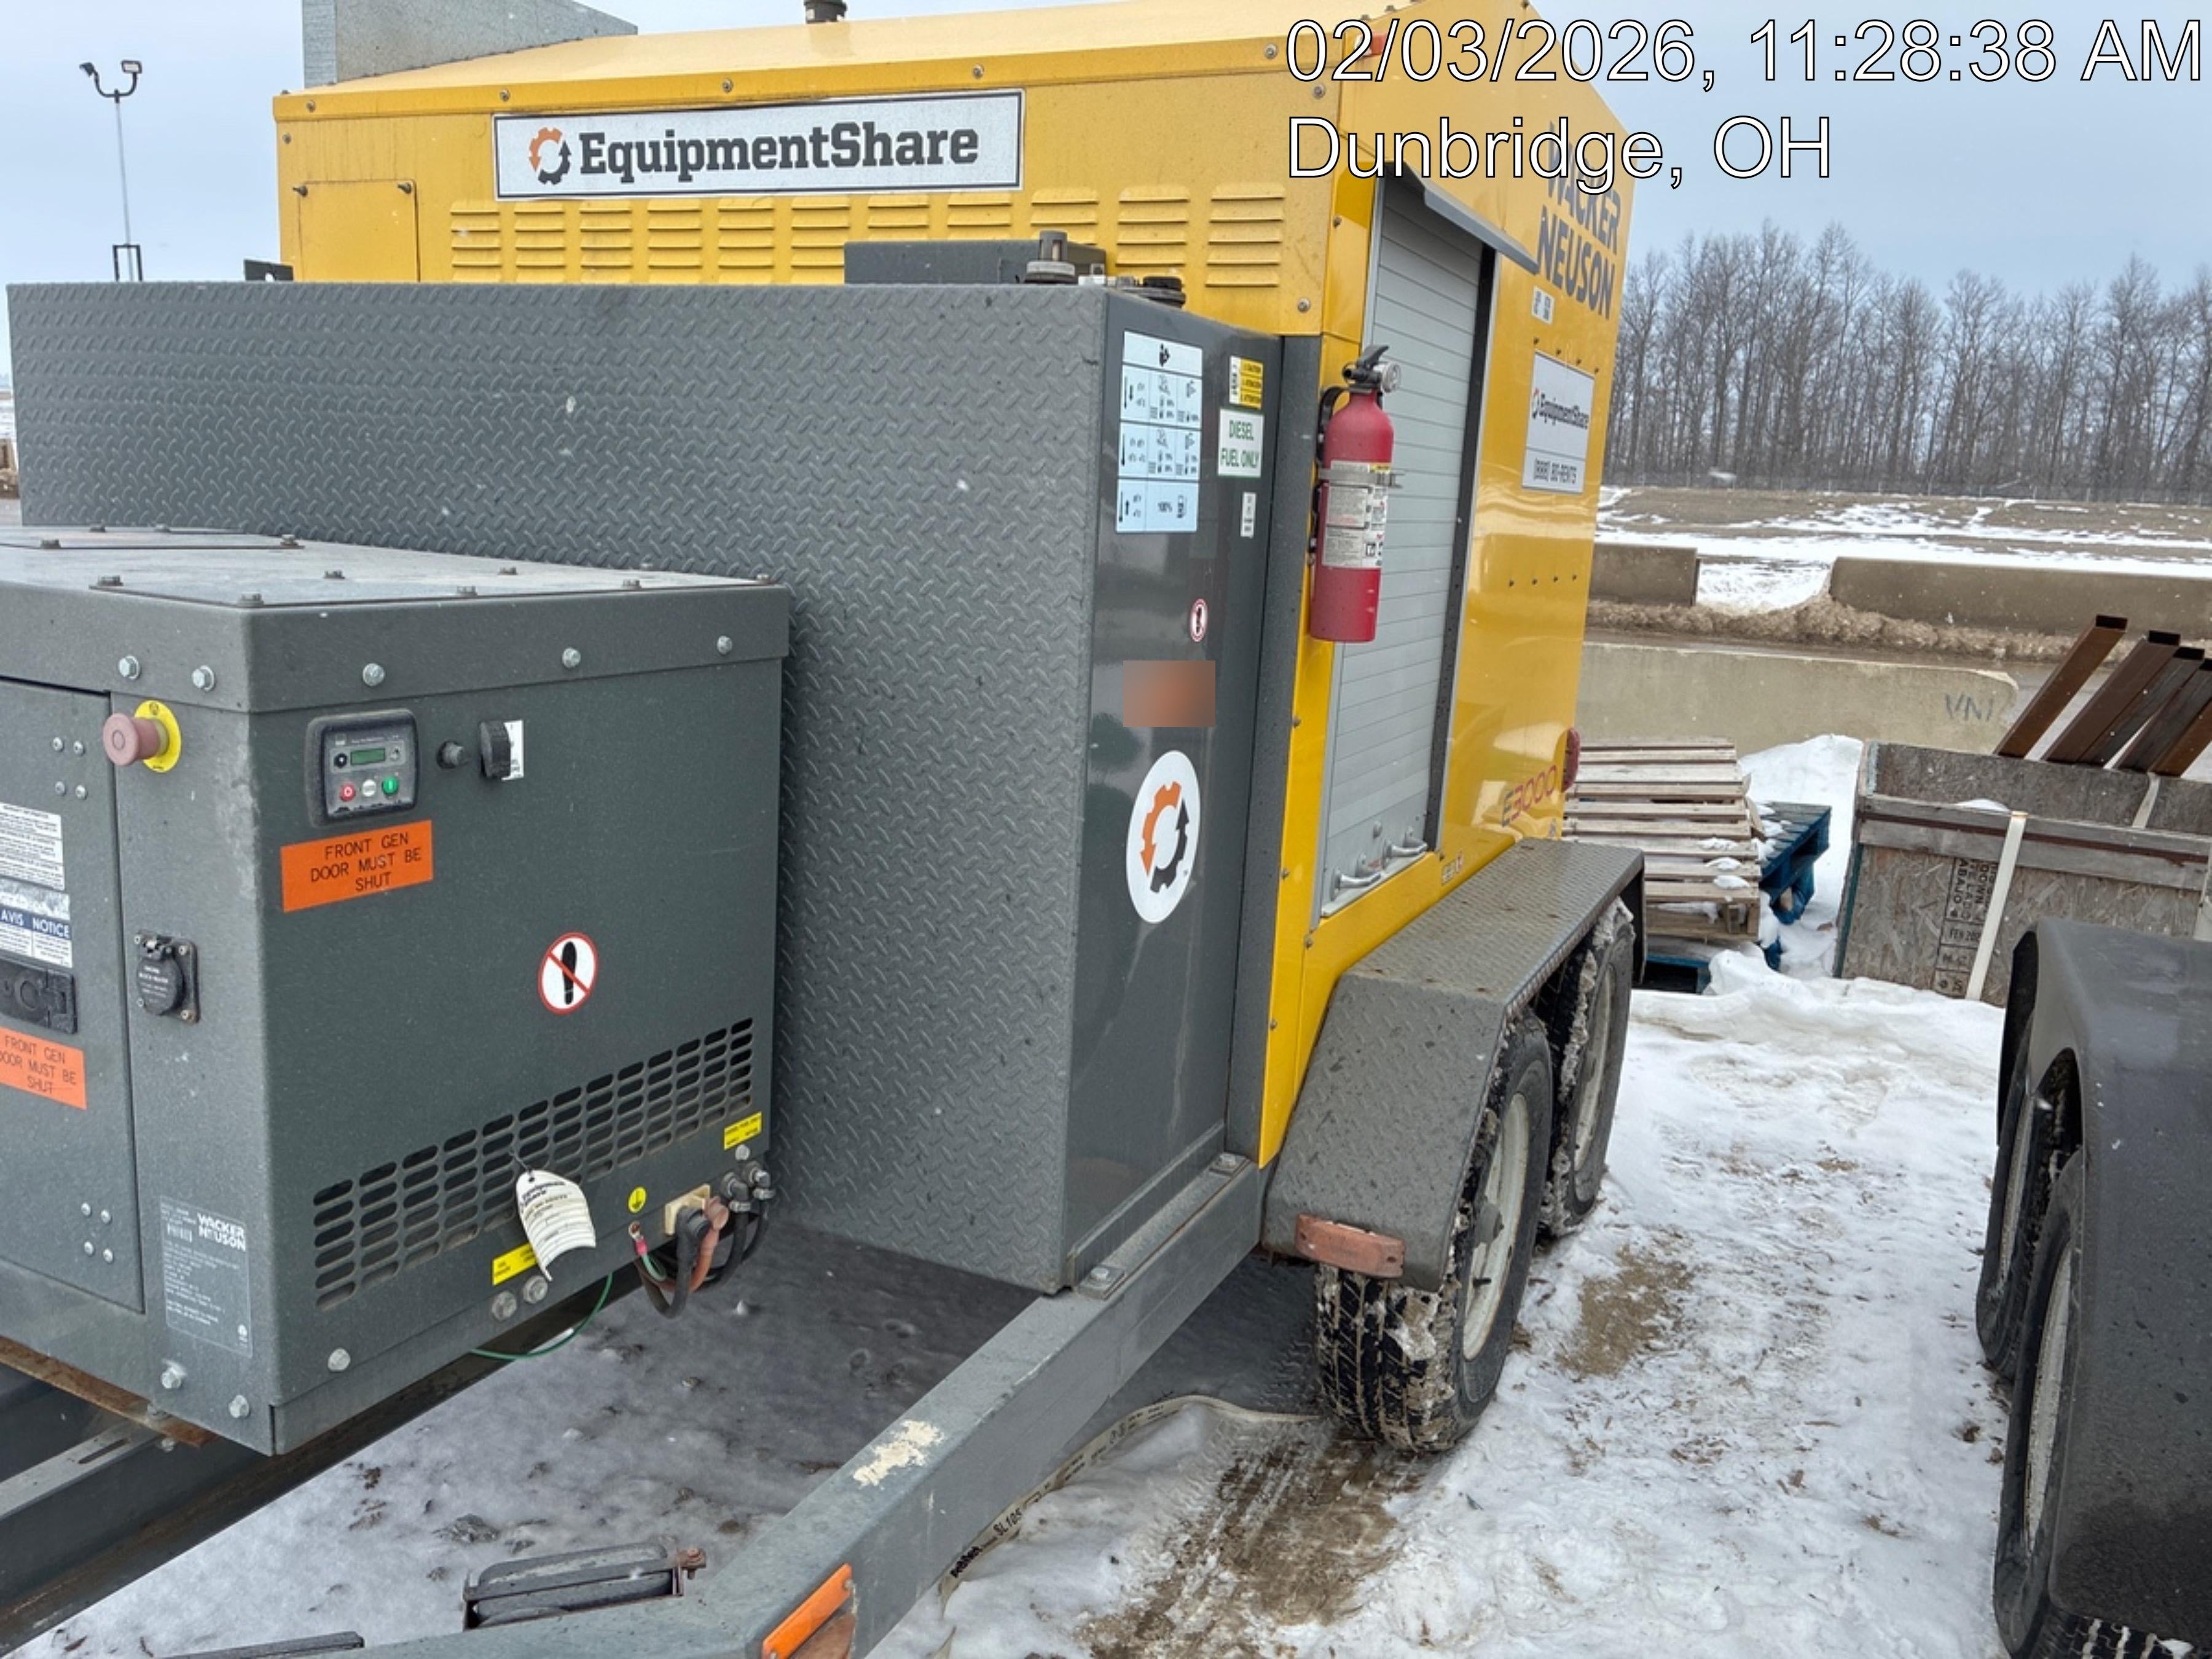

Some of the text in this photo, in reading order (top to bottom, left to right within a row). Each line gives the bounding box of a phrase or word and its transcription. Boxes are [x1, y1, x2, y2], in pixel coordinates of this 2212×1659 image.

[579, 121, 979, 183] EquipmentShare
[1537, 205, 1615, 320] NEUSON
[1230, 420, 1254, 441] DIESEL
[1221, 447, 1260, 469] FUEL ONLY
[324, 832, 409, 860] FRONT GEN
[311, 847, 422, 882] DOOR MUST BE
[355, 871, 391, 892] SHUT
[1, 909, 24, 927] AVIS
[33, 917, 69, 939] NOTICE
[5, 1035, 65, 1064] FRONT GEN
[27, 1075, 53, 1094] SHUT
[28, 1059, 56, 1079] MUST
[62, 1069, 77, 1086] BE
[197, 1212, 245, 1239] WACKER
[198, 1225, 246, 1252] NEUSON
